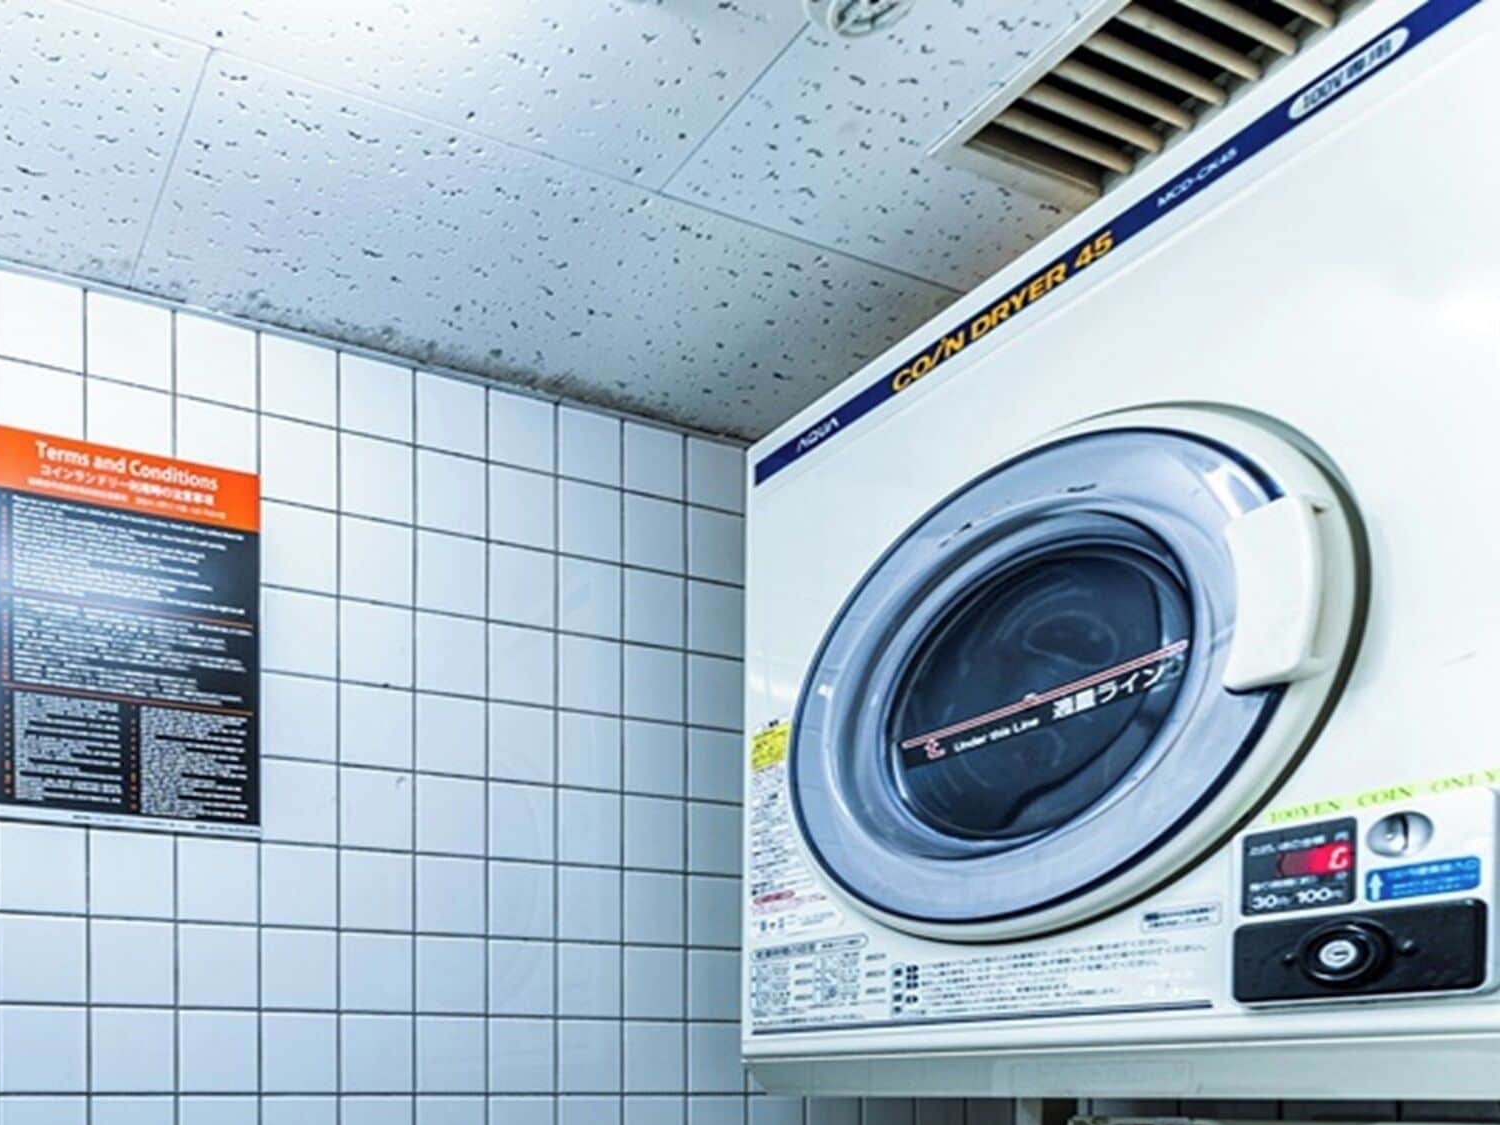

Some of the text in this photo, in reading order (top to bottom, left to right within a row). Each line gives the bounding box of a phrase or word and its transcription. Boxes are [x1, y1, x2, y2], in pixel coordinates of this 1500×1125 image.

[970, 261, 1068, 340] DRYER
[1074, 231, 1115, 268] 45
[35, 440, 89, 467] Terms
[92, 455, 127, 474] and
[128, 460, 219, 491] Conditions
[1013, 717, 1040, 733] Line
[1357, 785, 1414, 808] COIN
